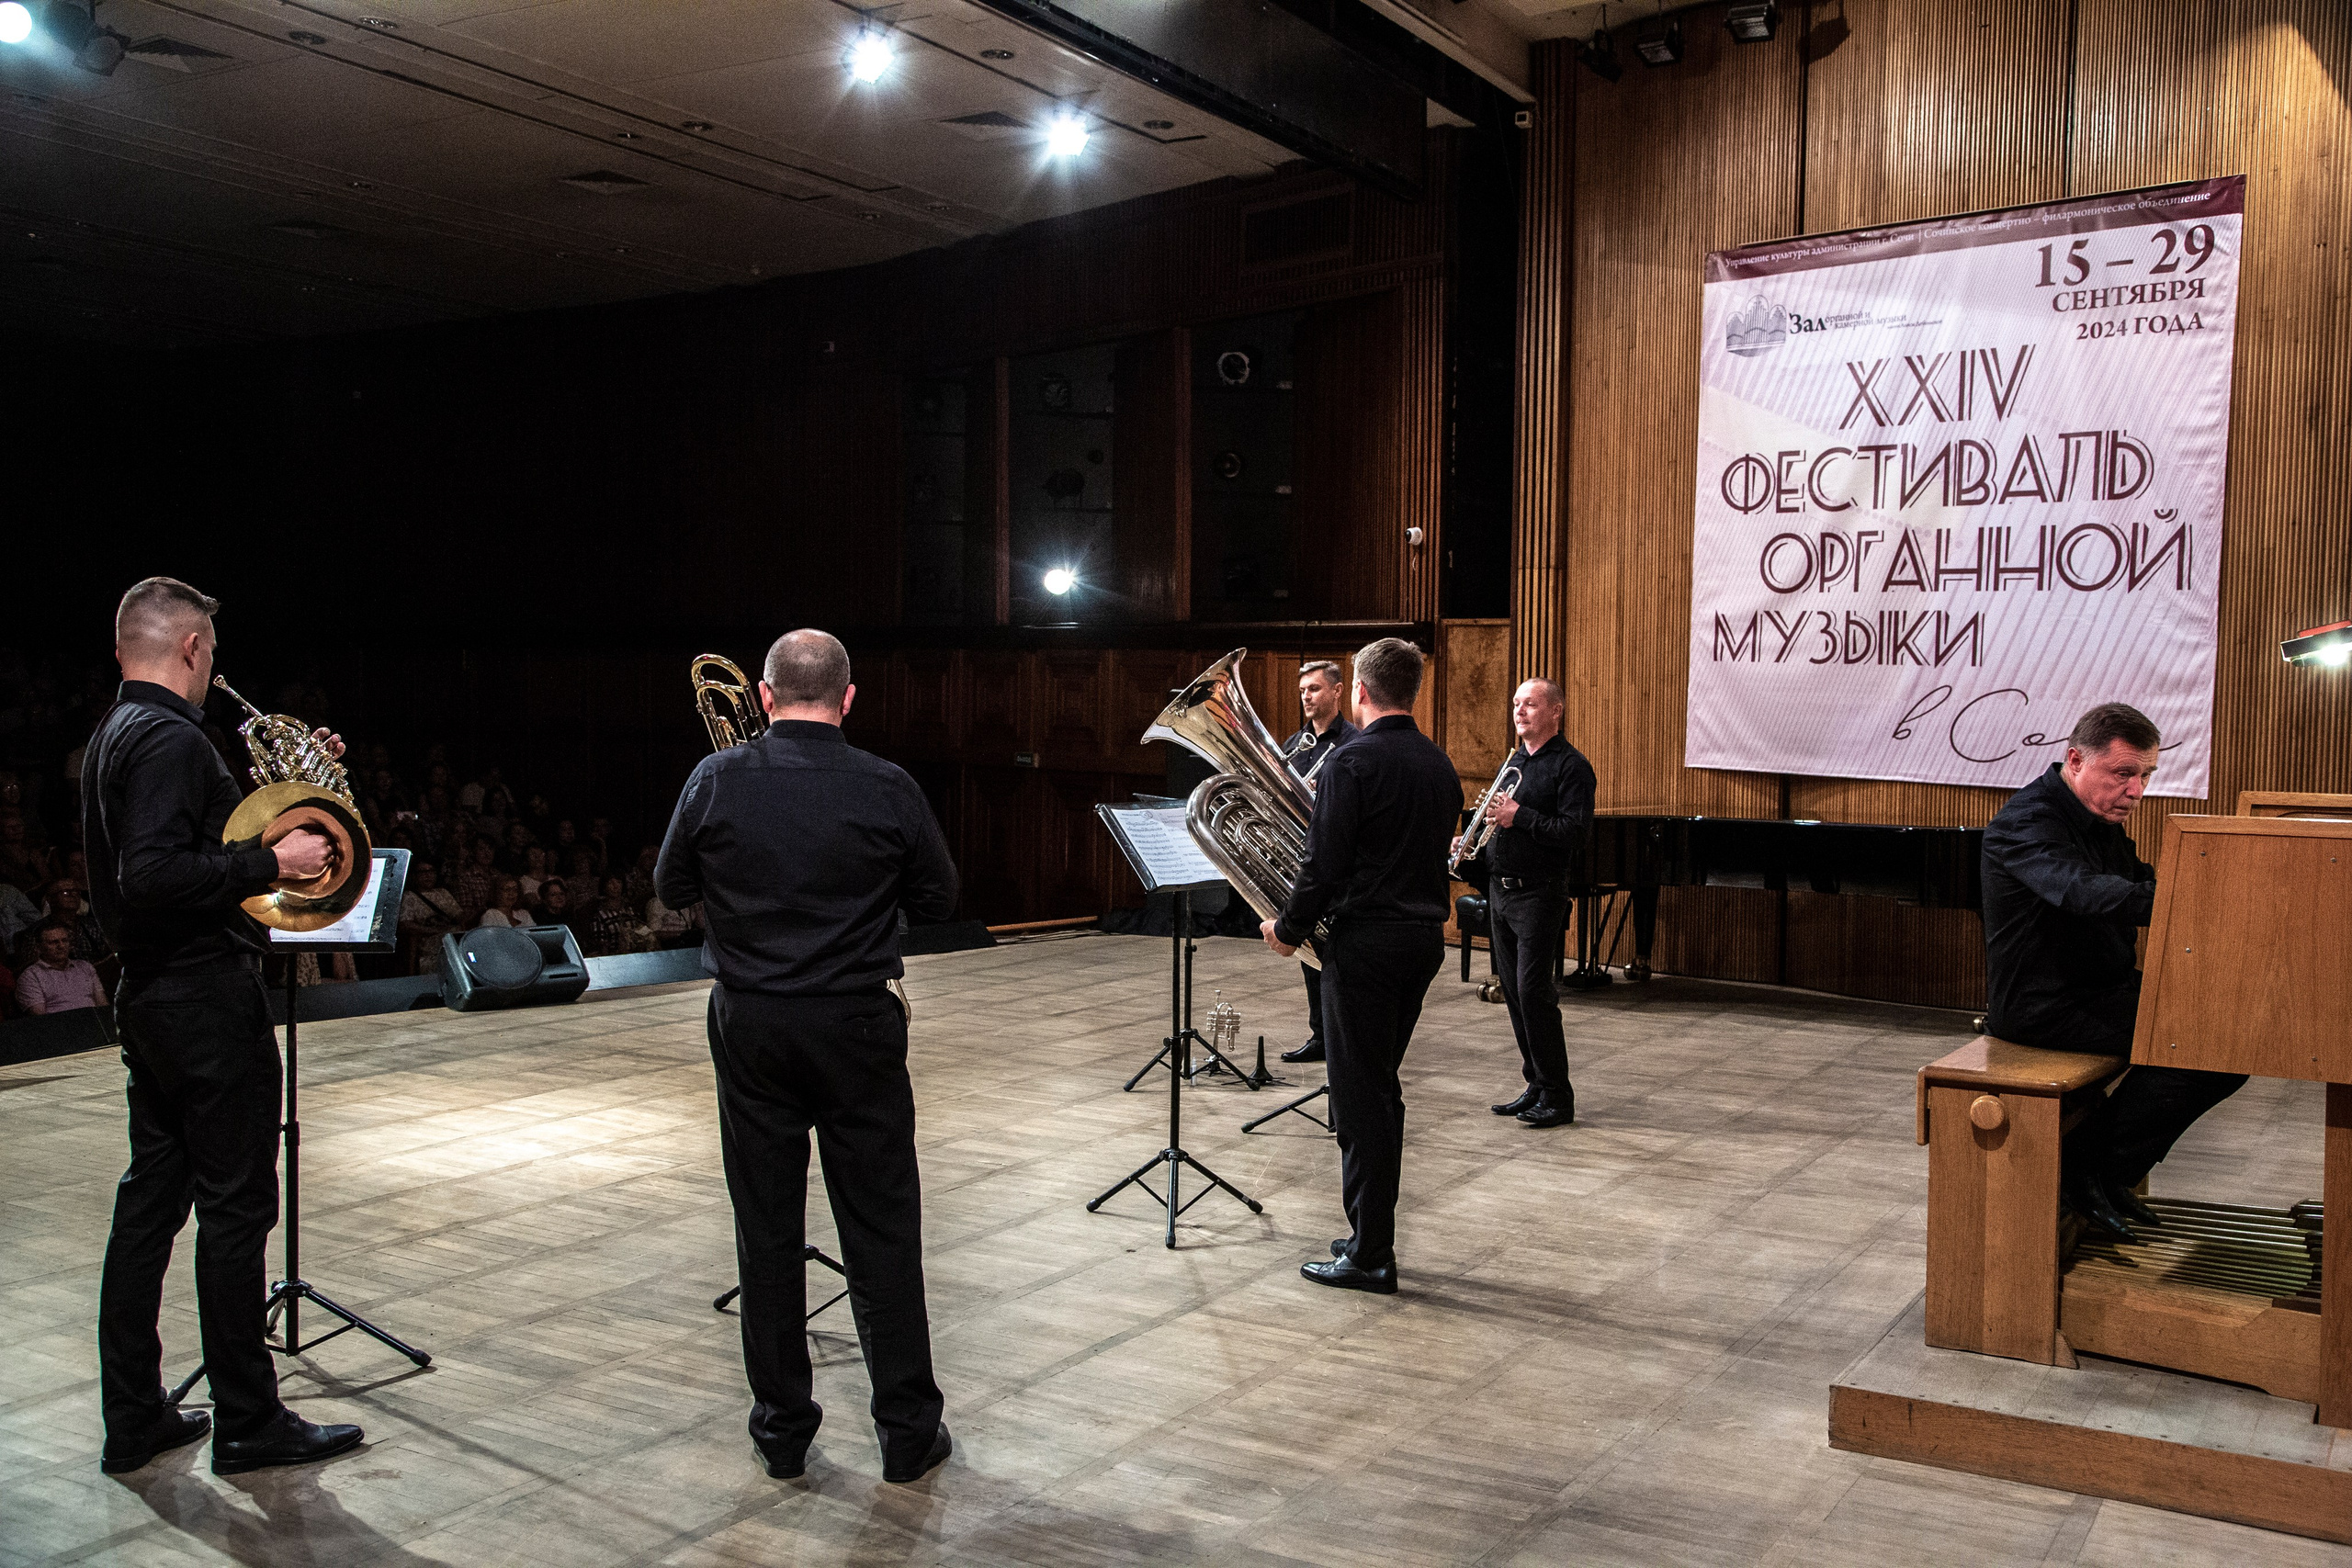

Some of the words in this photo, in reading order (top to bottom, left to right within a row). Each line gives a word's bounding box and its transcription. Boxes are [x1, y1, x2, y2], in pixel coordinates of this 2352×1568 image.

[1924, 224, 1975, 238] Сочинское
[1977, 217, 2031, 231] концертно
[2041, 202, 2136, 223] филармоническое
[2138, 191, 2211, 209] объединение
[1725, 253, 1770, 268] Управление
[1770, 248, 1810, 262] культуры
[1812, 239, 1880, 255] администрации
[1890, 233, 1915, 244] Сочи
[2035, 238, 2090, 288] 15
[2149, 223, 2215, 275] 29
[1825, 310, 1863, 325] органной
[2052, 277, 2207, 313] СЕНТЯБРЯ
[1789, 312, 1827, 334] Зал
[2076, 319, 2128, 341] 2024
[2133, 311, 2205, 336] ГОДА
[1838, 344, 2037, 430] XXIV
[1721, 429, 2154, 515] ФЕСТИВАЛЬ
[1759, 508, 2193, 594] ОРГАННОЙ
[1713, 609, 1985, 669] МУЗЫКИ
[1892, 684, 1952, 740] в
